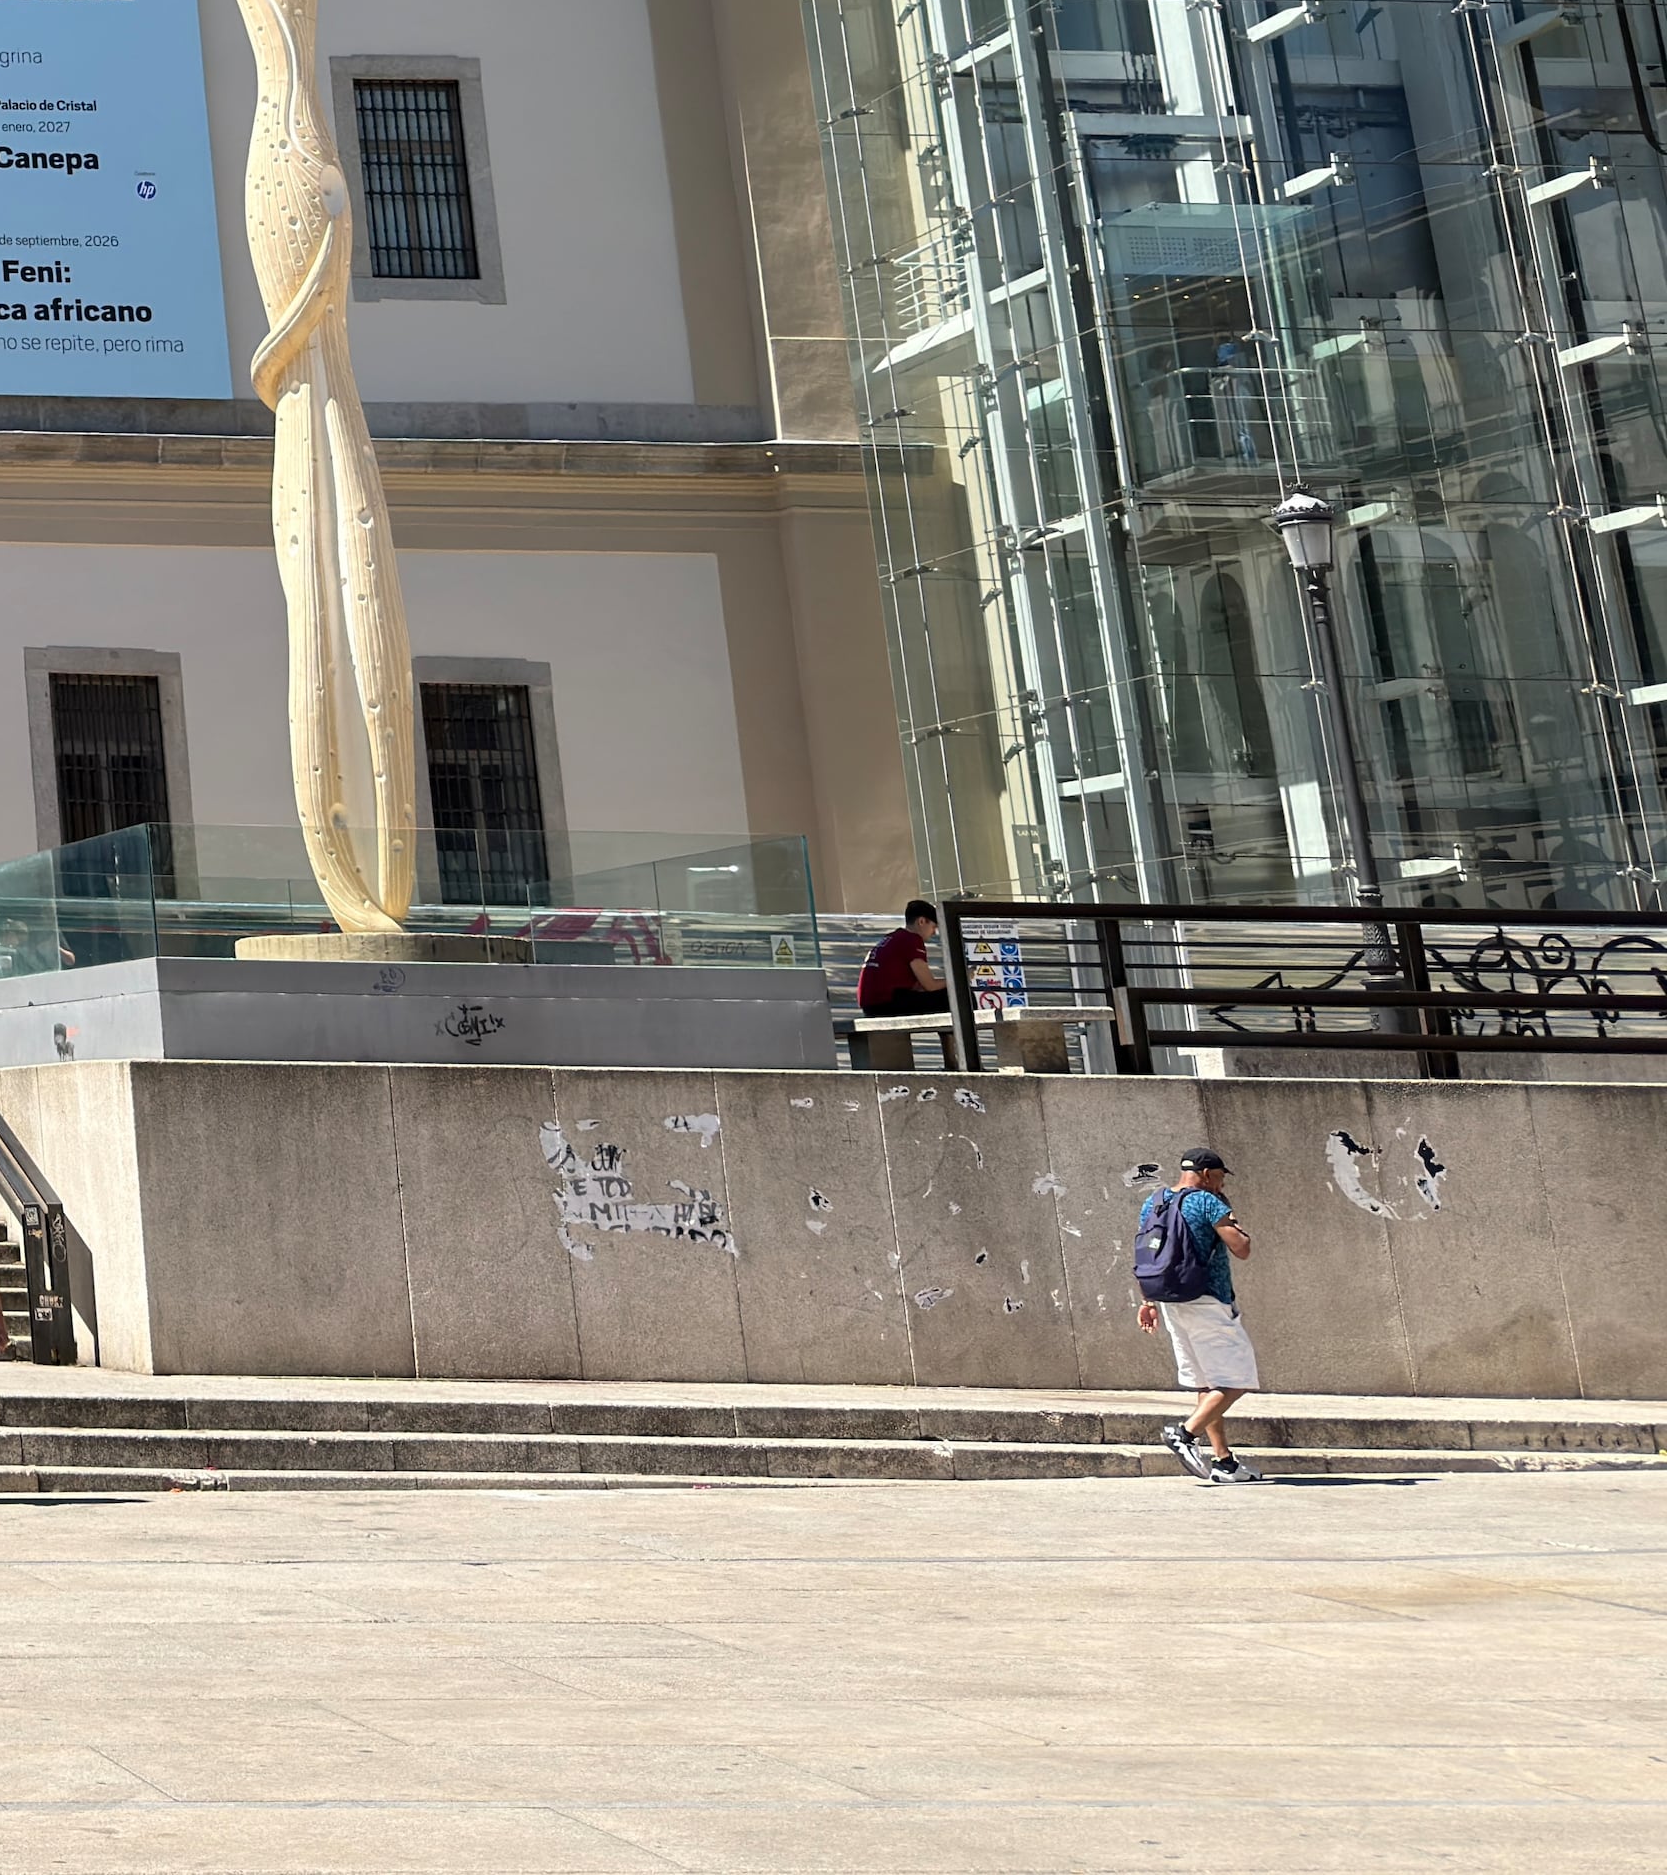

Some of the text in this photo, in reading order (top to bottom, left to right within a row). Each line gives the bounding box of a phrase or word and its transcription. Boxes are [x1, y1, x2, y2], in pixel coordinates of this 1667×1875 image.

[39, 99, 54, 111] de
[56, 100, 97, 111] Cristal
[1, 123, 36, 133] enero,
[38, 121, 71, 133] 2027
[15, 235, 82, 249] septiembre,
[85, 235, 119, 247] 2026
[2, 260, 71, 283] Feni:
[34, 297, 152, 323] africano
[21, 337, 41, 351] se
[45, 334, 99, 355] repite,
[103, 339, 141, 355] pero
[145, 336, 184, 353] rima
